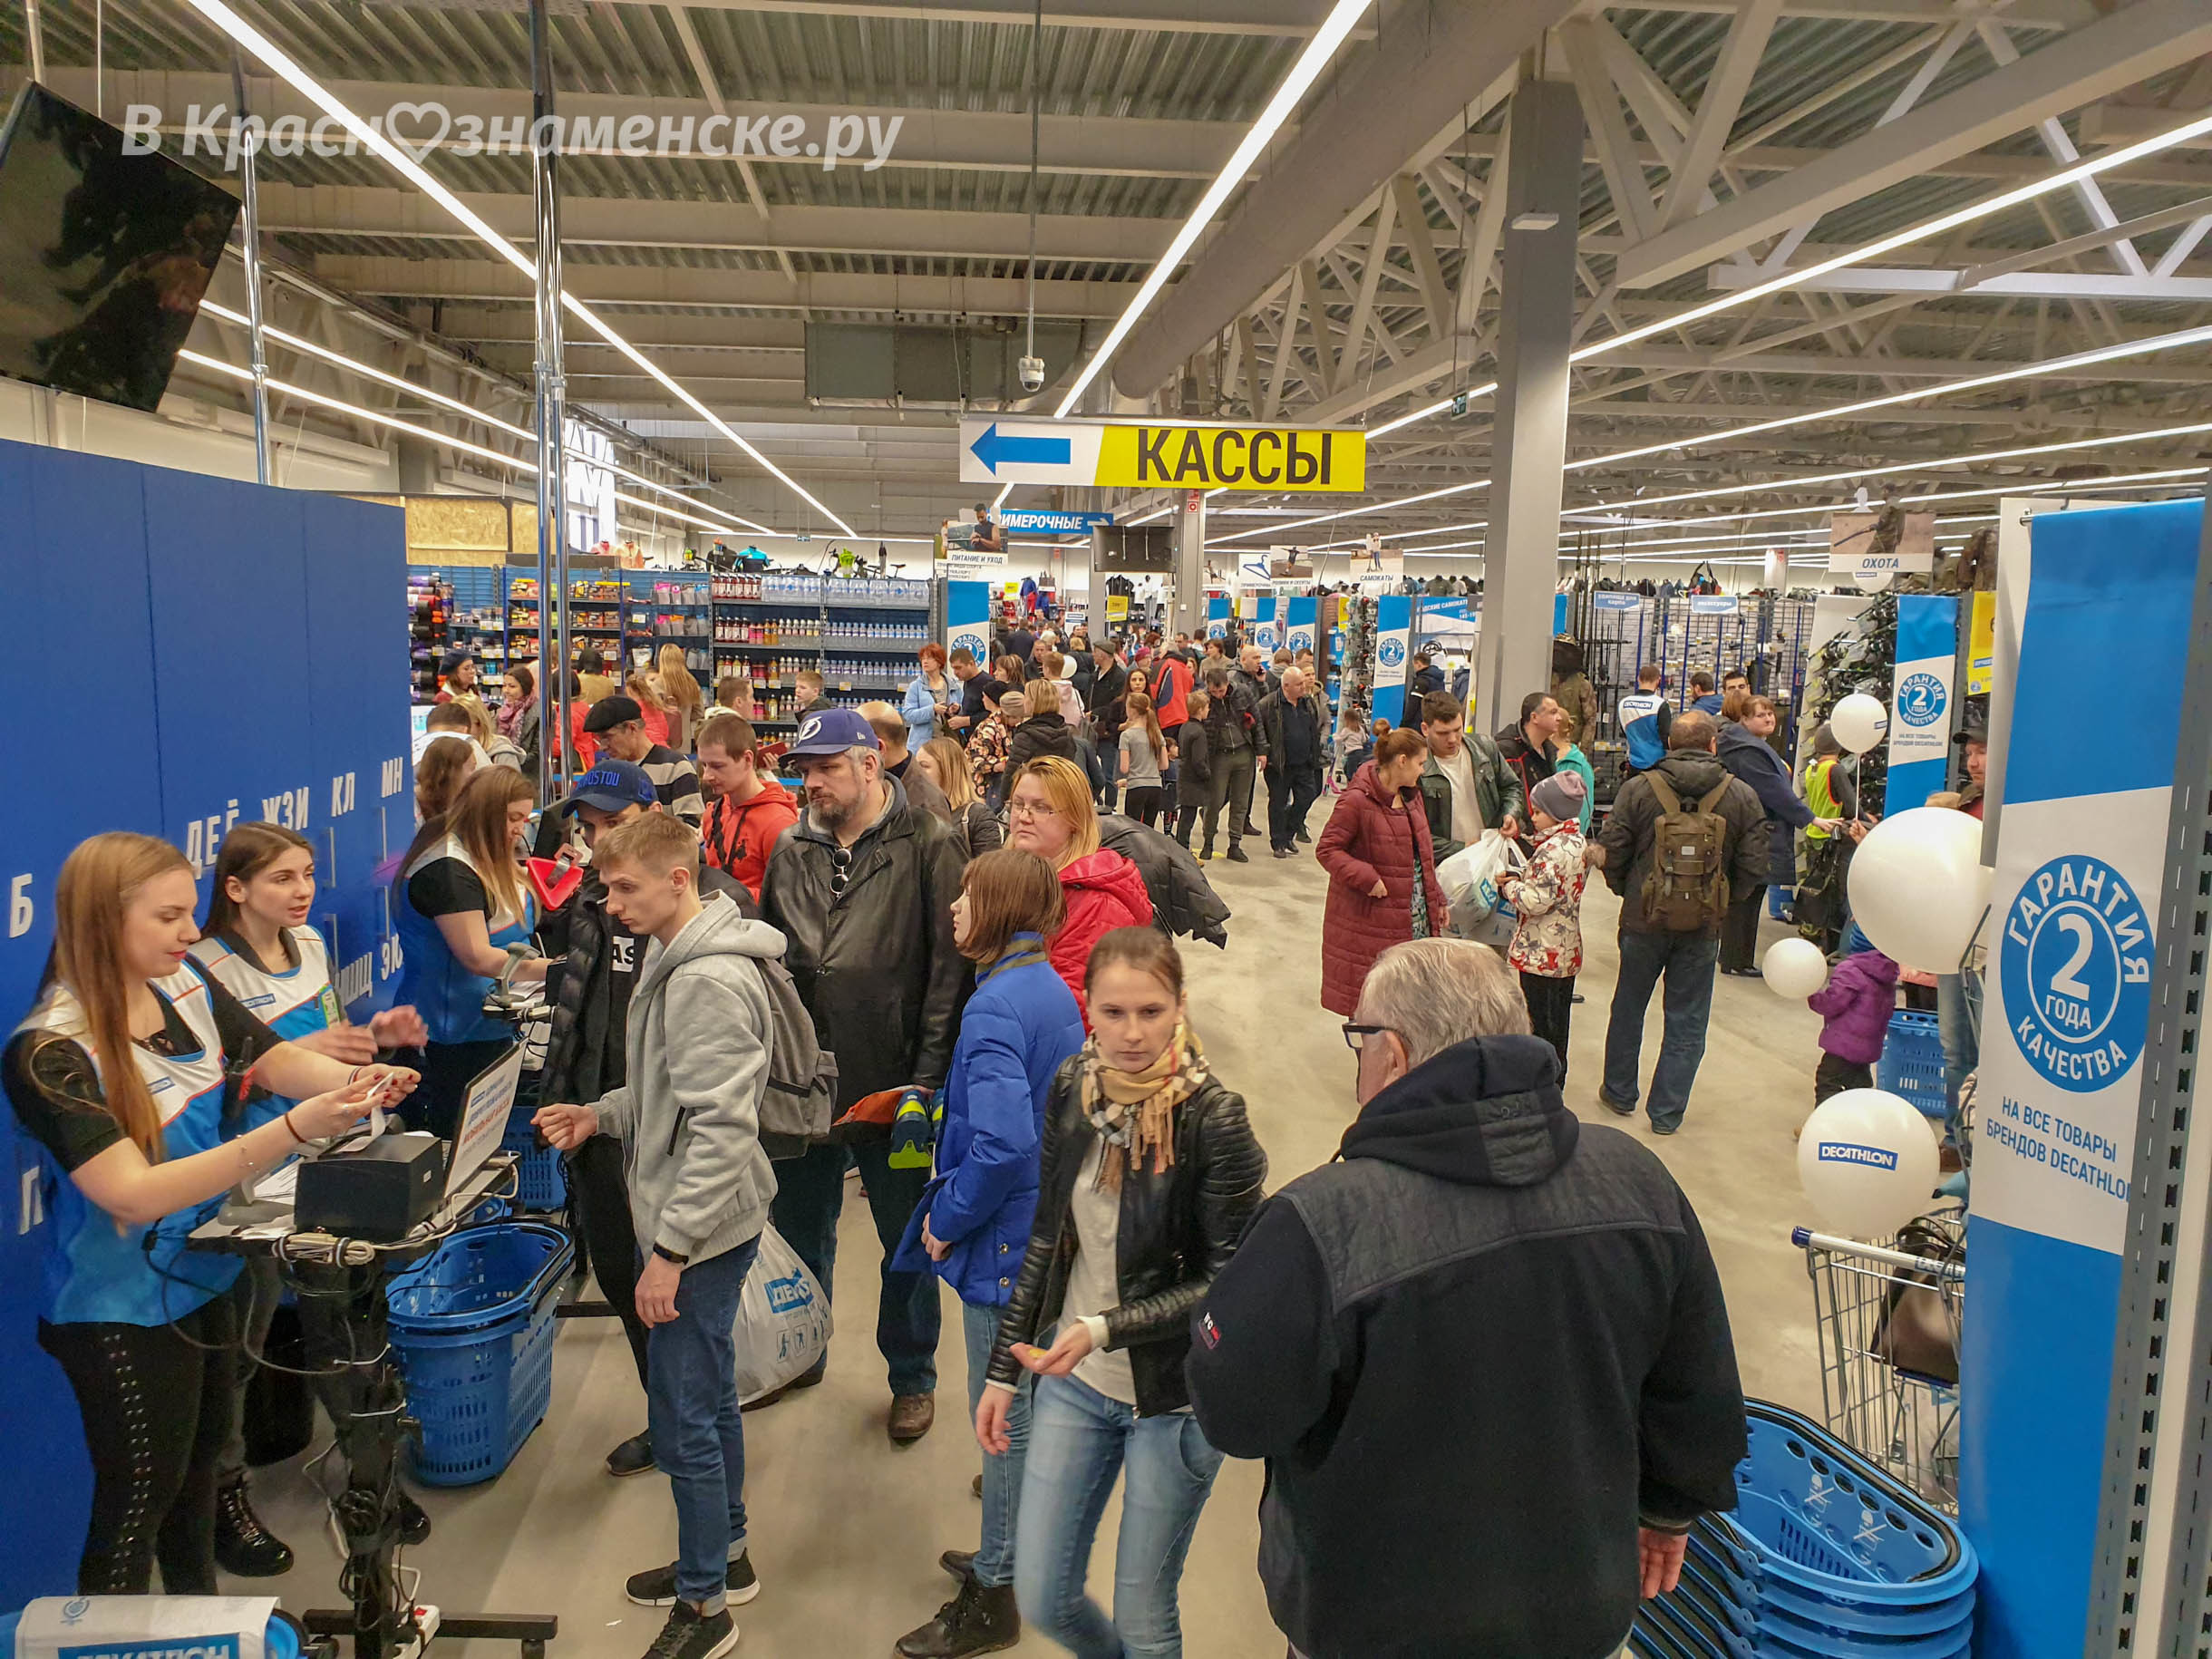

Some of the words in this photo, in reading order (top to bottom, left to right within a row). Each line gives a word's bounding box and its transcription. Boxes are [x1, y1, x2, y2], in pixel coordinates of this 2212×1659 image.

[1137, 428, 1333, 486] КАССЫ
[987, 512, 1083, 530] ИМЕРОЧНЫЕ
[951, 554, 980, 564] ПИТАНИЕ
[986, 556, 1003, 565] УХОД
[1862, 558, 1899, 568] ОХОТА
[1263, 632, 1269, 640] 2
[1296, 637, 1304, 646] 2
[1388, 645, 1395, 655] 2
[1900, 674, 1945, 700] ГАРАНТИЯ
[1912, 686, 1927, 706] 2
[1902, 711, 1939, 726] КАЧЕСТВА
[262, 786, 310, 831] ЖЗИ
[331, 771, 355, 818] КЛ
[185, 799, 240, 880] ДЕЁ
[9, 873, 34, 938] Б
[2008, 862, 2149, 985] ГАРАНТИЯ
[2050, 913, 2094, 1001] 2
[2045, 994, 2091, 1031] ГОДА
[2017, 1014, 2128, 1081] КАЧЕСТВА
[1985, 1118, 2047, 1165] БРЕНДОВ
[2002, 1095, 2021, 1121] НА
[2023, 1102, 2050, 1135] ВСЕ
[2054, 1118, 2117, 1163] ТОВАРЫ
[1821, 1145, 1894, 1167] DECATHLON
